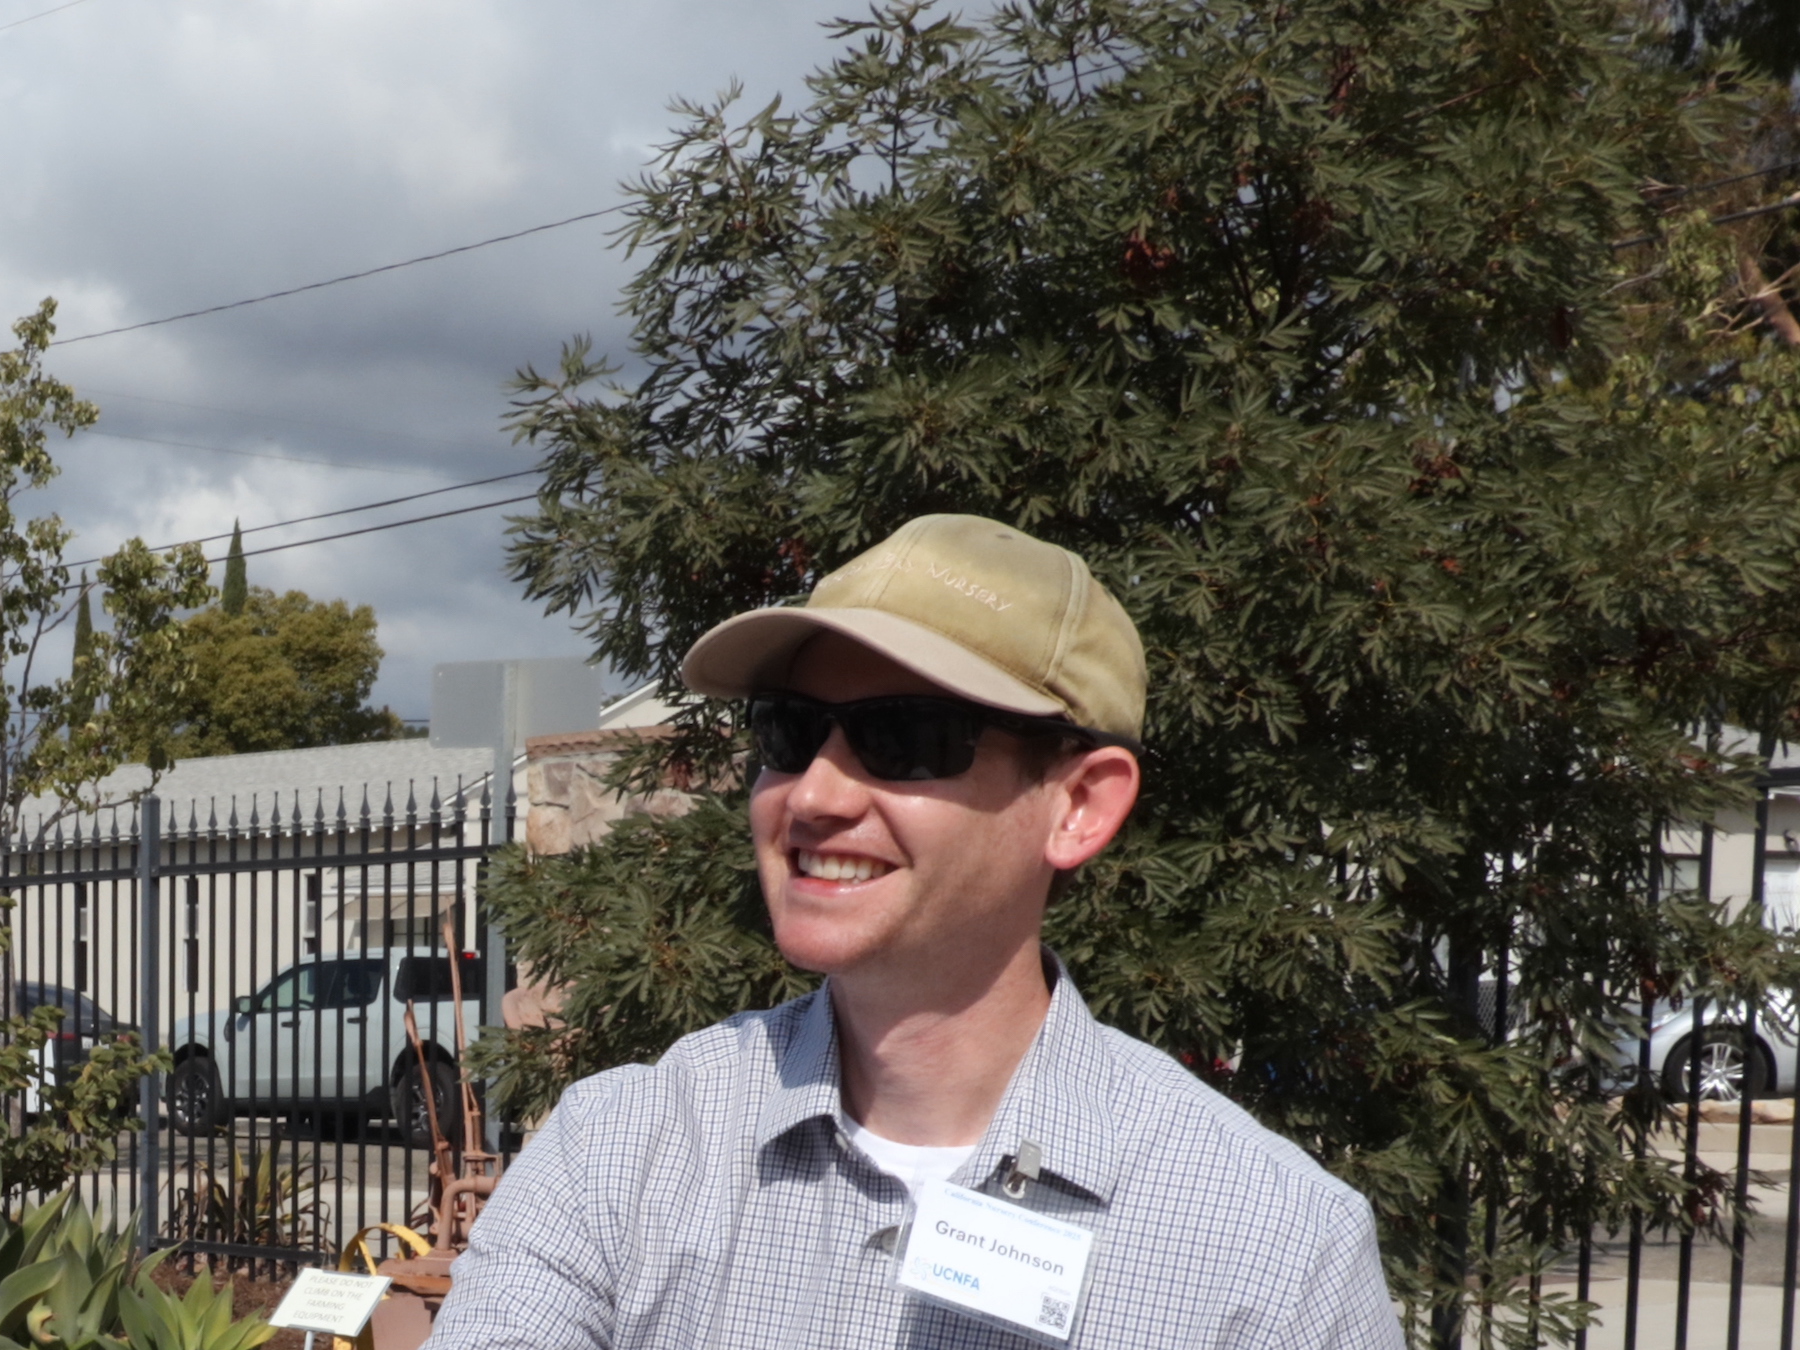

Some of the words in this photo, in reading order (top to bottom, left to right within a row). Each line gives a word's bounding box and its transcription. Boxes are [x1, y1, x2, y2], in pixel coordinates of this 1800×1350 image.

[926, 562, 1013, 612] NURSERY
[944, 1188, 983, 1206] California
[986, 1203, 1016, 1219] Nursery
[1018, 1213, 1061, 1234] Conference
[935, 1220, 985, 1249] Grant
[989, 1239, 1064, 1276] Johnson
[310, 1275, 338, 1284] PLEASE
[932, 1263, 980, 1291] UCNFA
[304, 1287, 330, 1295] CLIMB
[331, 1289, 345, 1297] ON
[347, 1291, 363, 1300] THE
[307, 1299, 345, 1310] FARMING
[293, 1311, 344, 1322] EQUIPMENT
